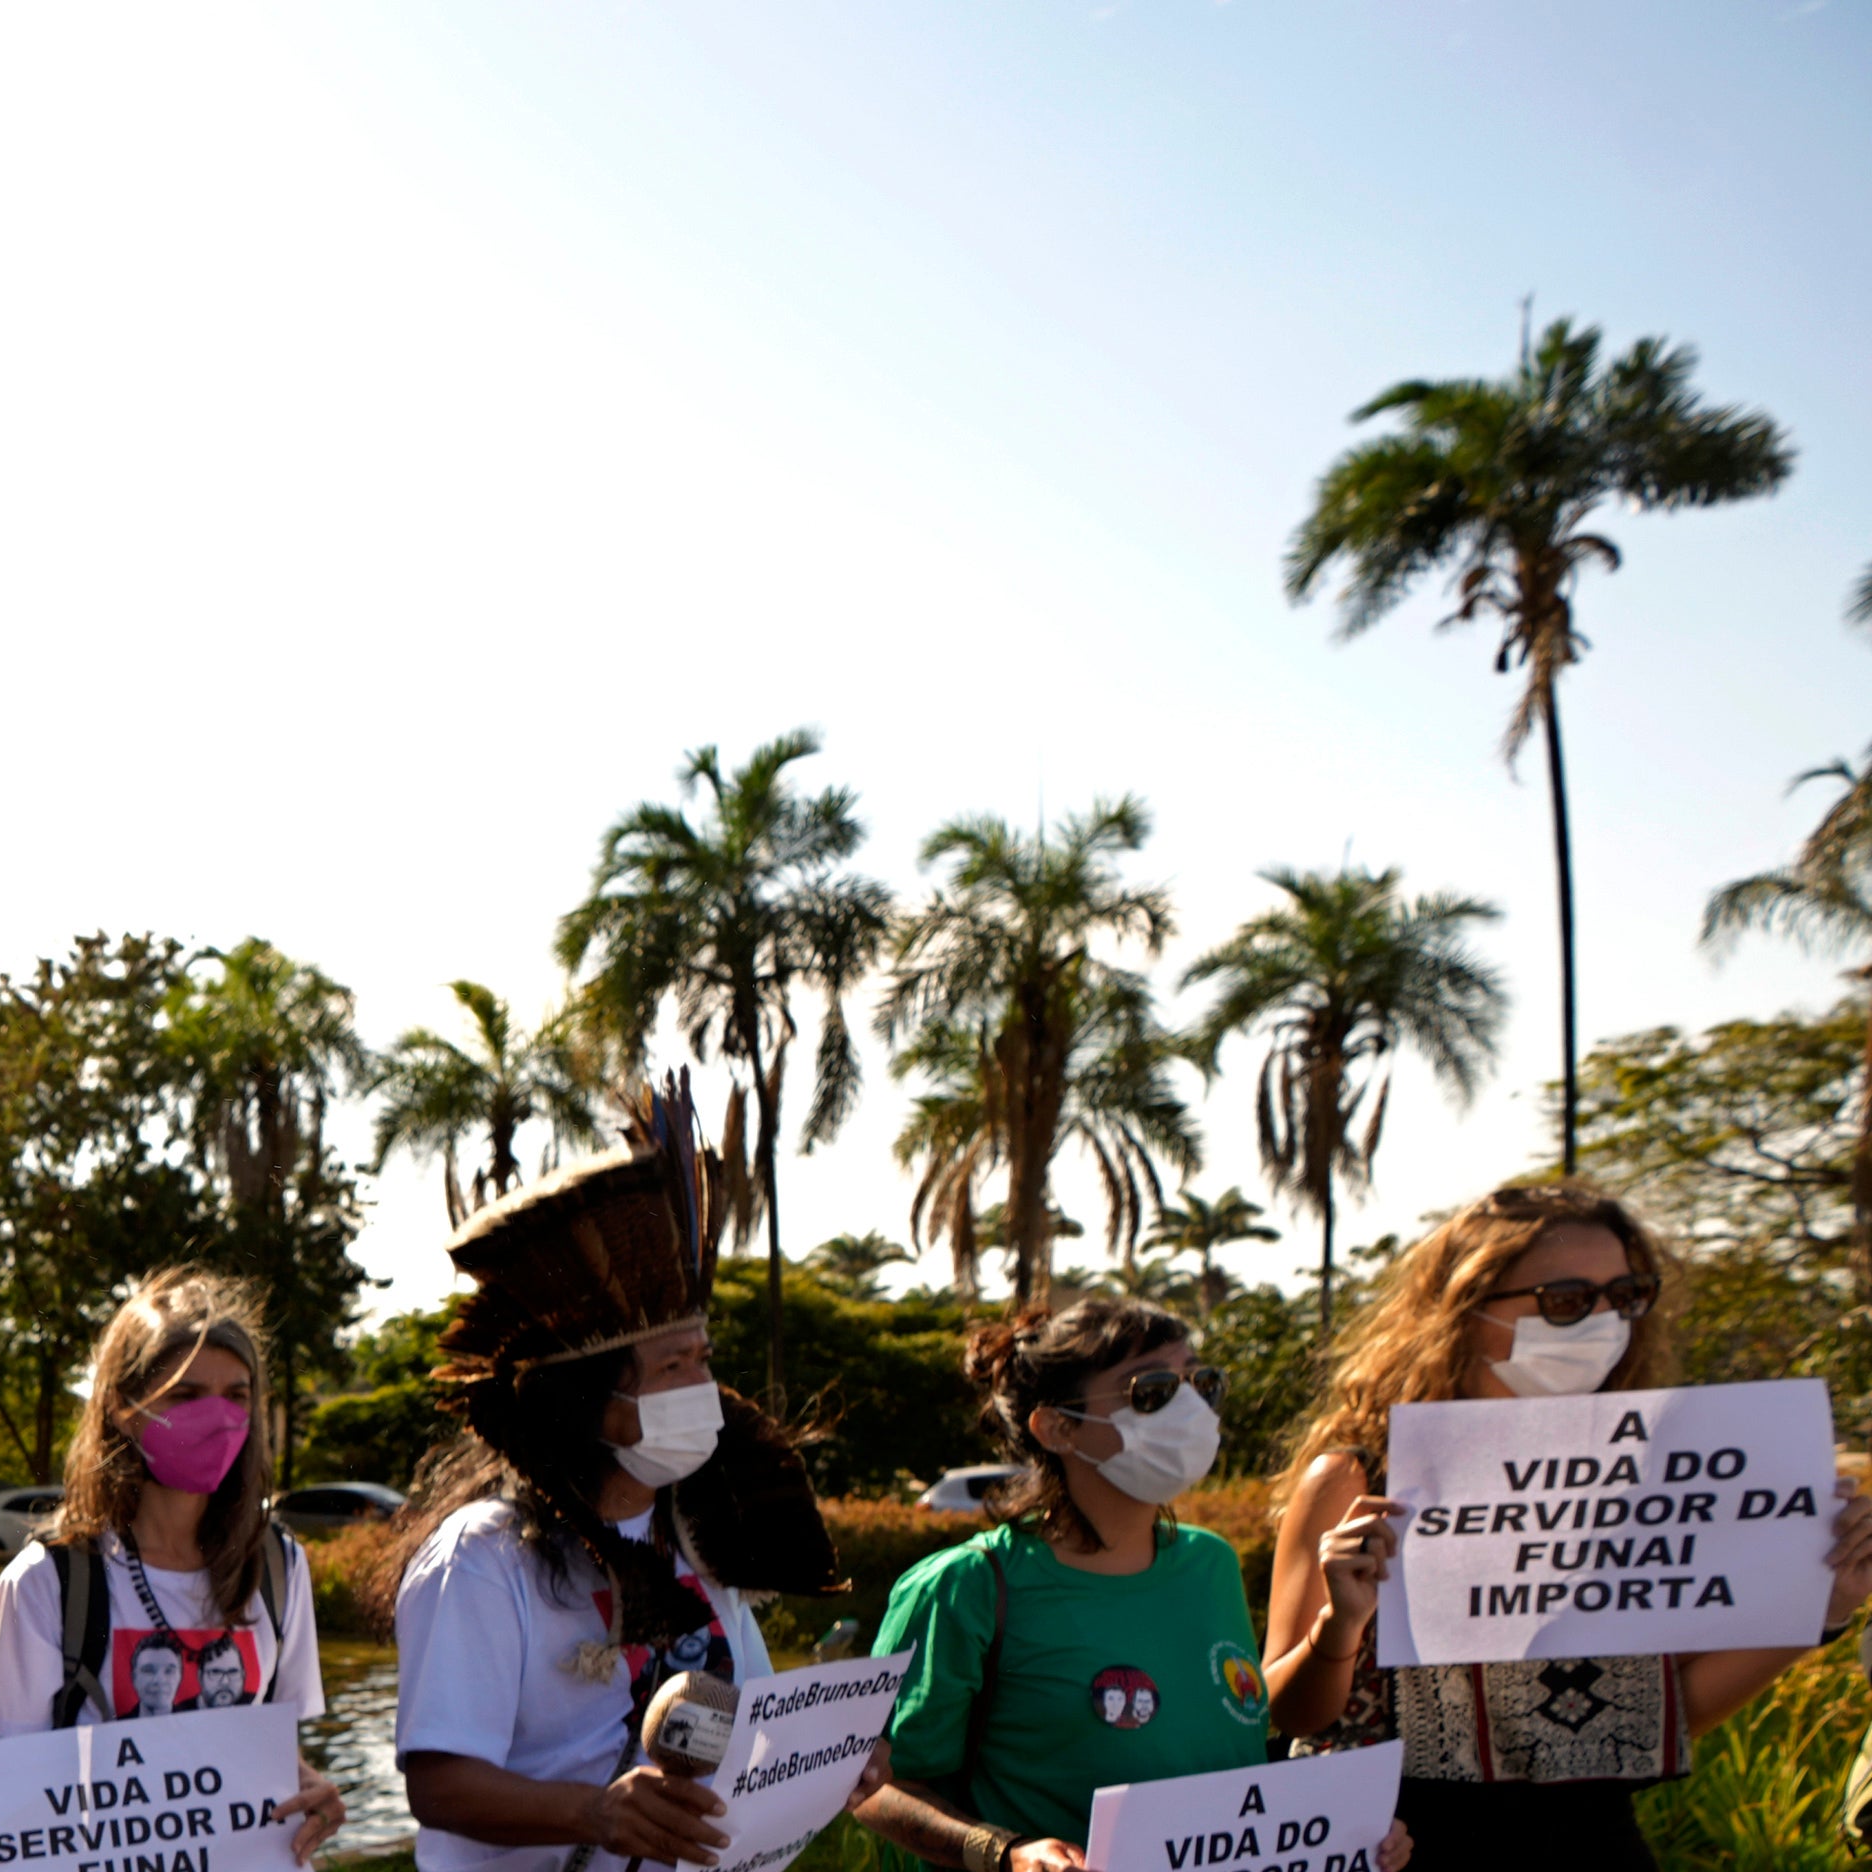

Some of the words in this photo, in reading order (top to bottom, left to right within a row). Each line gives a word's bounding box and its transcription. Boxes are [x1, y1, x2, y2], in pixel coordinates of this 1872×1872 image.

[1609, 1410, 1649, 1444] A
[1503, 1455, 1641, 1492] VIDA
[1663, 1448, 1747, 1484] DO
[1416, 1497, 1717, 1537] SERVIDOR
[1737, 1487, 1817, 1521] DA
[1514, 1534, 1697, 1573] FUNAI
[1469, 1576, 1736, 1618] IMPORTA
[116, 1737, 145, 1768] A
[44, 1776, 150, 1816] VIDA
[164, 1766, 223, 1799] DO
[1238, 1784, 1266, 1818] A
[229, 1797, 286, 1833] DA
[1165, 1827, 1261, 1871] VIDA
[1277, 1816, 1330, 1853] DO
